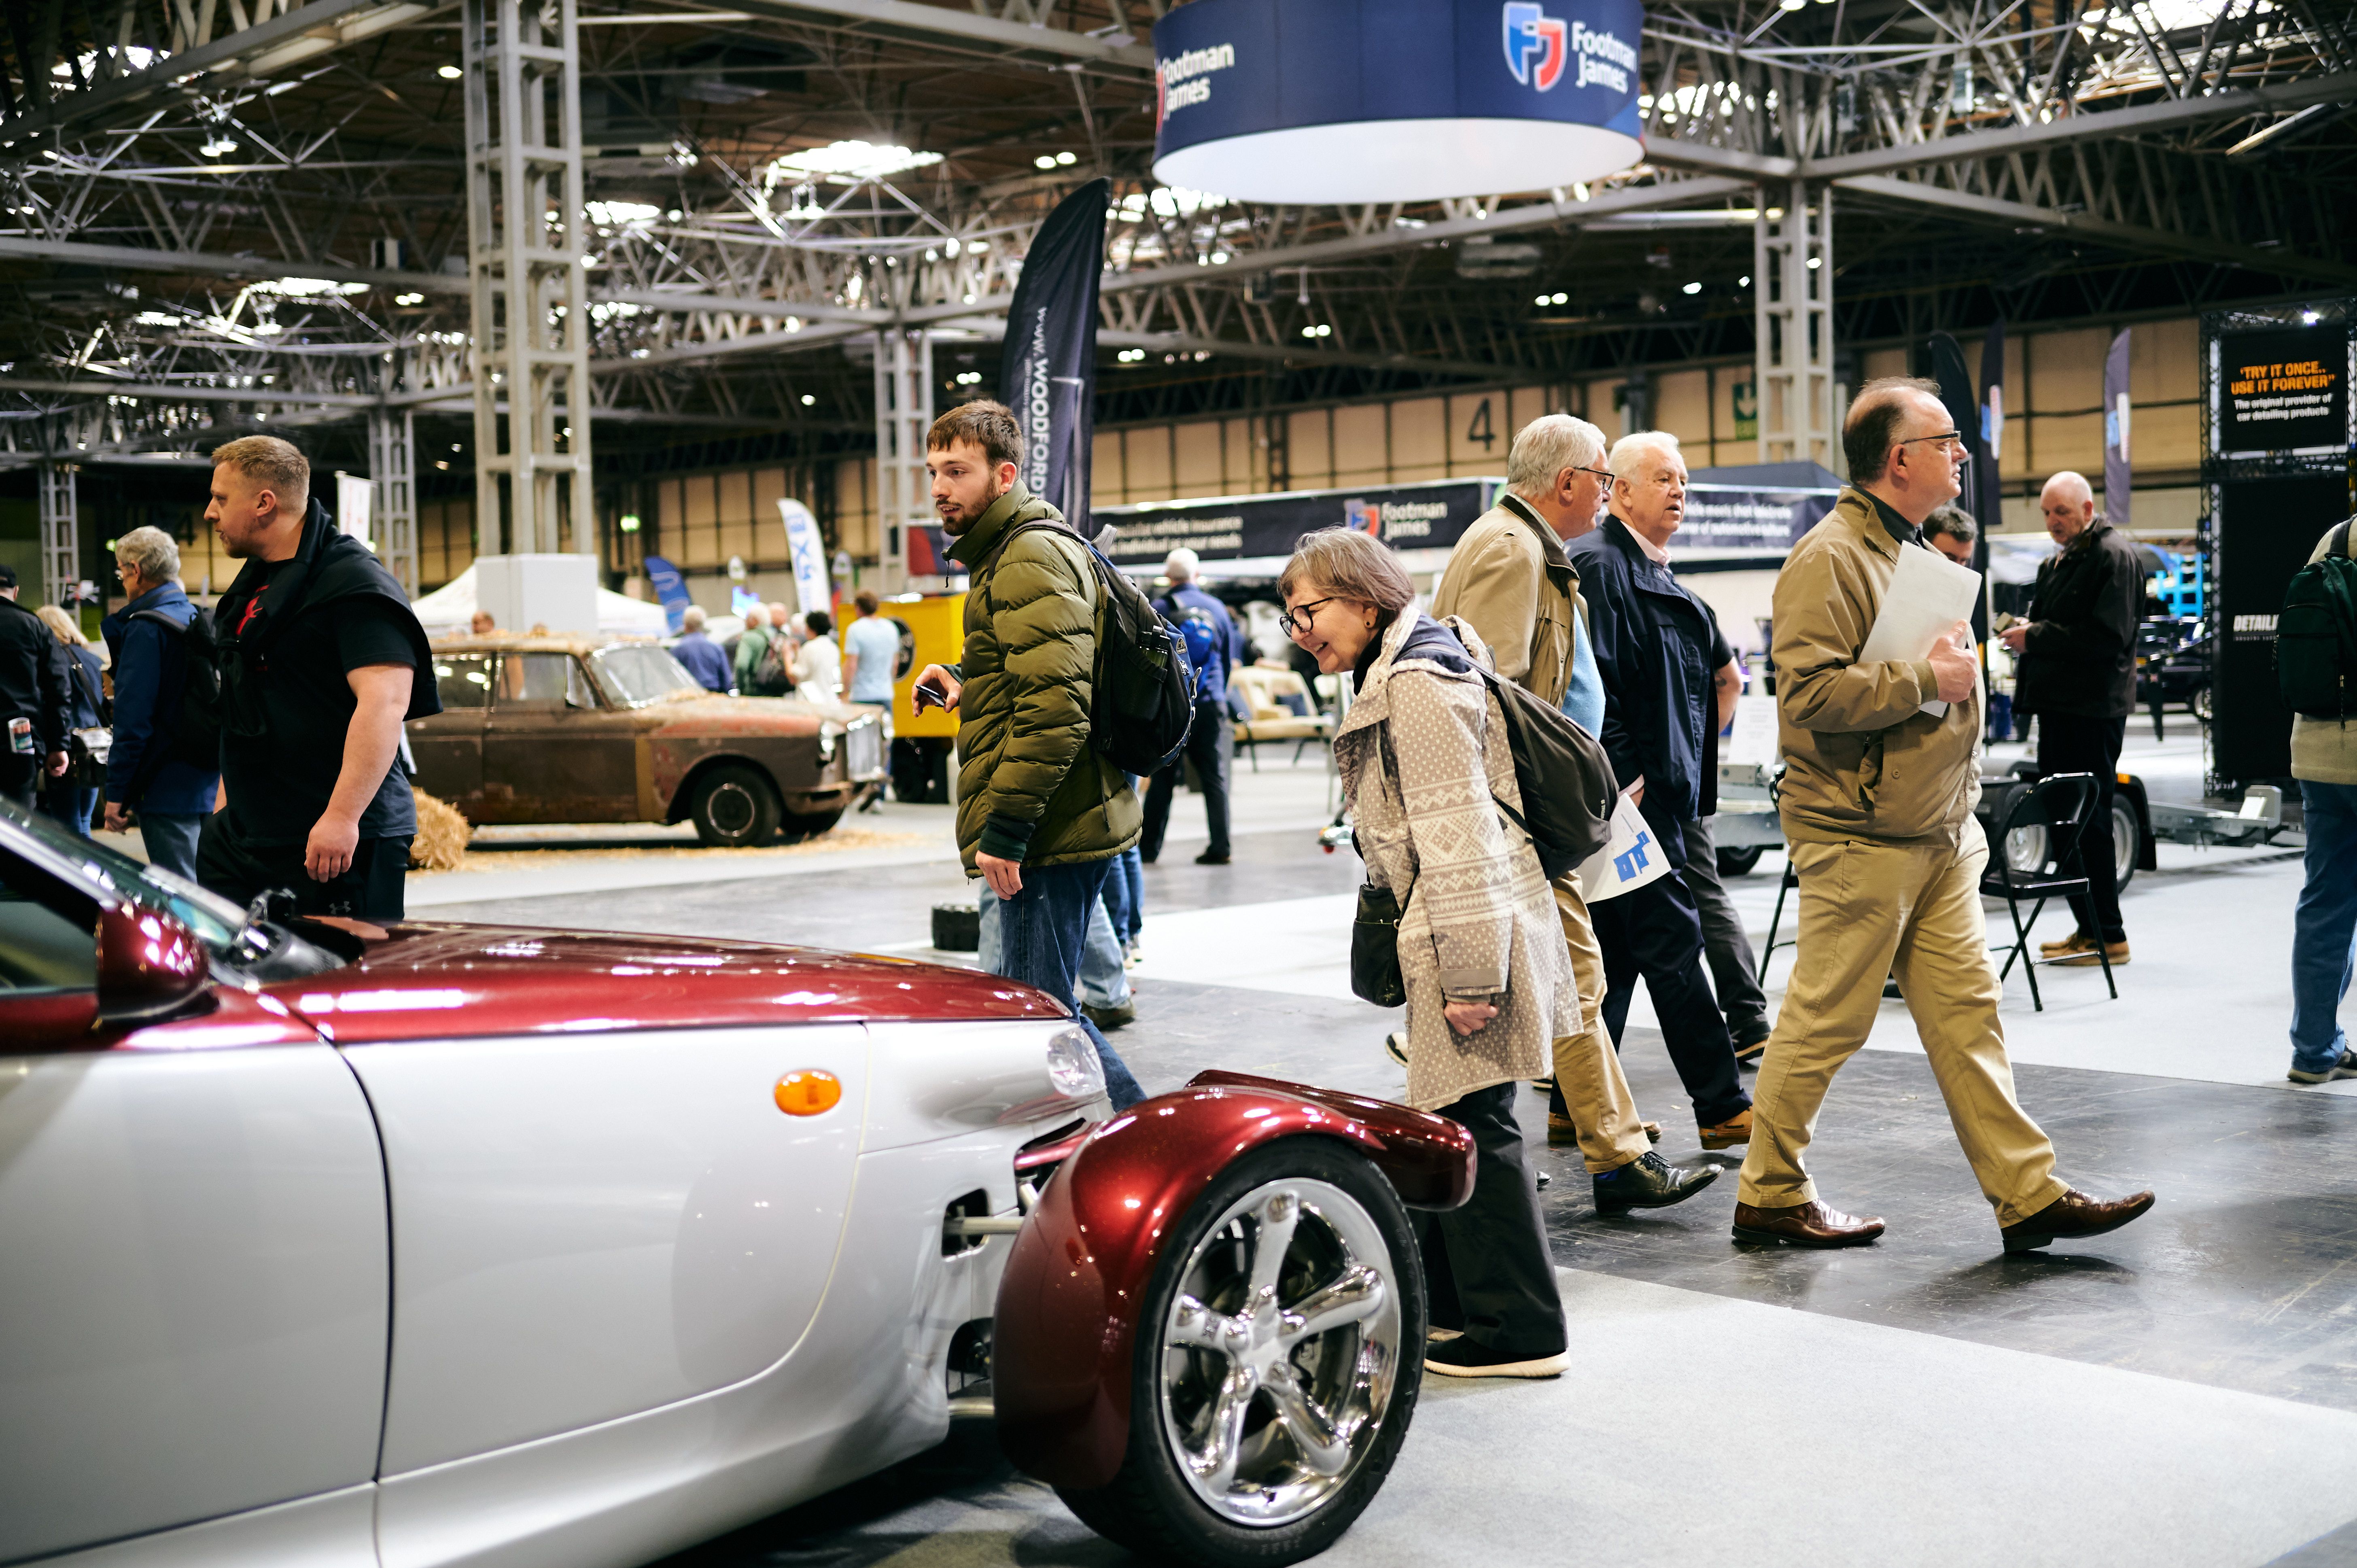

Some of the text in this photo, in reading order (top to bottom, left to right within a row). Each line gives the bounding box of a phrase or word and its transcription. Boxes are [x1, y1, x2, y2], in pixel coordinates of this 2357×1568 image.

[1572, 20, 1637, 73] Footman
[1576, 52, 1628, 94] James
[2270, 364, 2283, 377] IT
[2231, 380, 2255, 395] USE
[2258, 379, 2270, 393] IT
[2234, 399, 2250, 410] The
[2251, 396, 2284, 409] original
[2285, 394, 2322, 407] provider
[2252, 409, 2289, 421] detailing
[2290, 406, 2330, 420] products
[1468, 398, 1496, 452] 4
